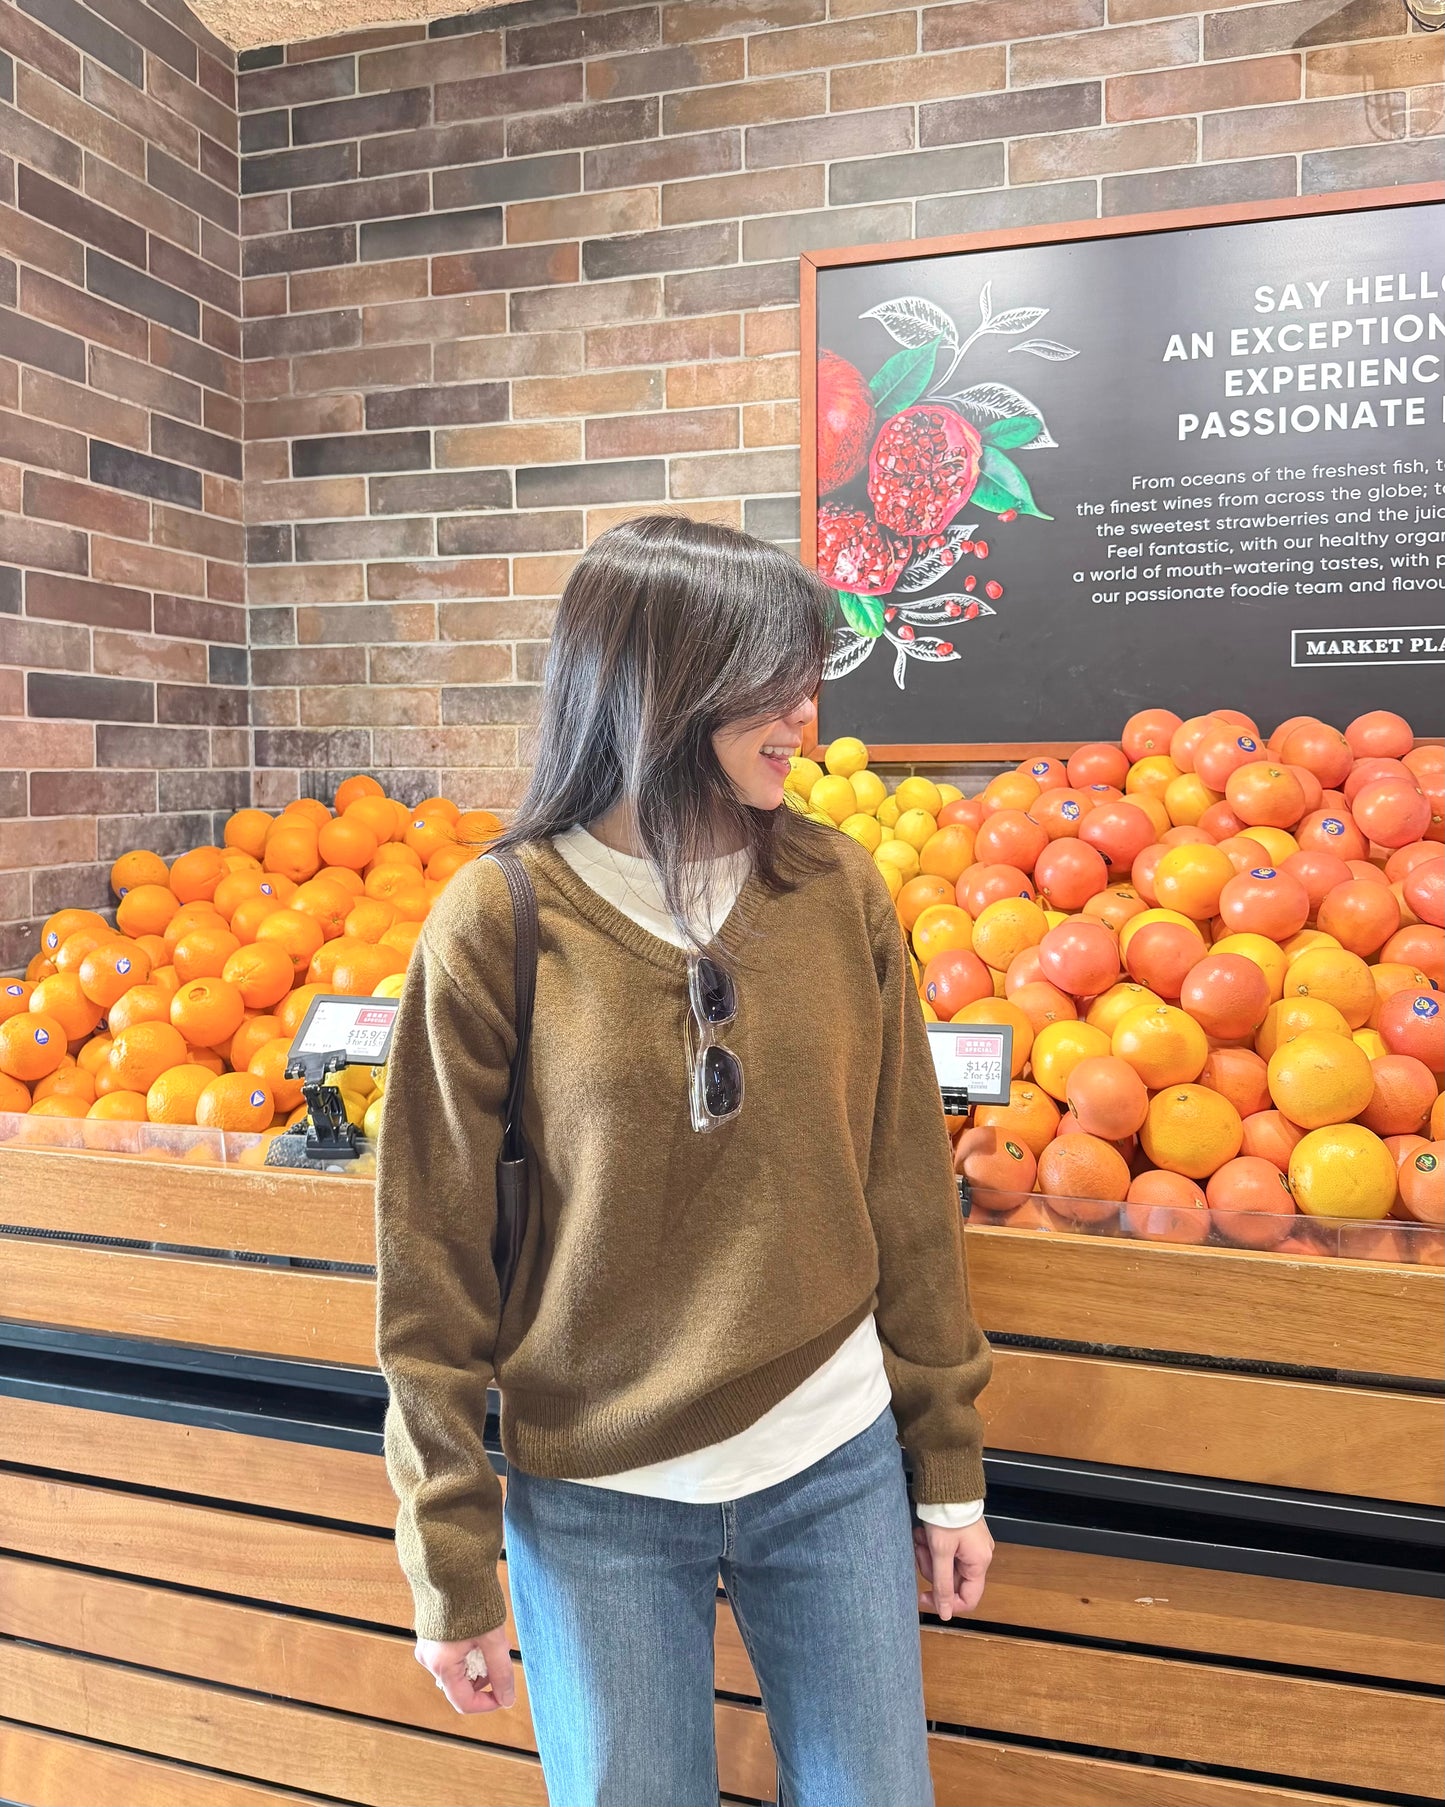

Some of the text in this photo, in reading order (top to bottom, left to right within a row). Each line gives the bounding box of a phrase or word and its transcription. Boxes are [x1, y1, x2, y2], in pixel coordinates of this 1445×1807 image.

[1254, 271, 1445, 314] SAY HELL
[1162, 331, 1214, 362] AN
[1178, 397, 1426, 441] PASSIONATE
[1132, 458, 1444, 490] From oceans of the freshest fish, t
[1075, 502, 1105, 516] the
[1109, 498, 1158, 514] finest
[1162, 495, 1213, 511] wines
[1217, 492, 1259, 507] from
[1264, 490, 1325, 505] across
[1330, 486, 1362, 501] the
[1367, 483, 1428, 502] globe;
[1095, 522, 1126, 537] the
[1130, 518, 1211, 535] sweetest
[1216, 511, 1329, 530] strawberries
[1334, 508, 1371, 524] and
[1377, 507, 1409, 522] the
[1107, 542, 1143, 559] Feel
[1148, 538, 1234, 557] fantastic,
[1239, 536, 1278, 552] with
[1283, 537, 1314, 550] our
[1319, 531, 1390, 549] healthy
[1072, 571, 1085, 583] a
[1089, 565, 1138, 582] world
[1142, 563, 1162, 579] of
[1166, 558, 1314, 578] mouth-watering
[1319, 556, 1384, 571] tastes,
[1389, 552, 1430, 568] with
[1091, 591, 1121, 604] our
[1125, 585, 1226, 606] passionate
[1229, 581, 1290, 598] foodie
[1294, 581, 1343, 595] team
[1348, 577, 1386, 593] and
[1305, 637, 1404, 656] MARKET
[963, 1071, 1001, 1081] 2 for $14
[966, 1060, 1001, 1074] $14/2
